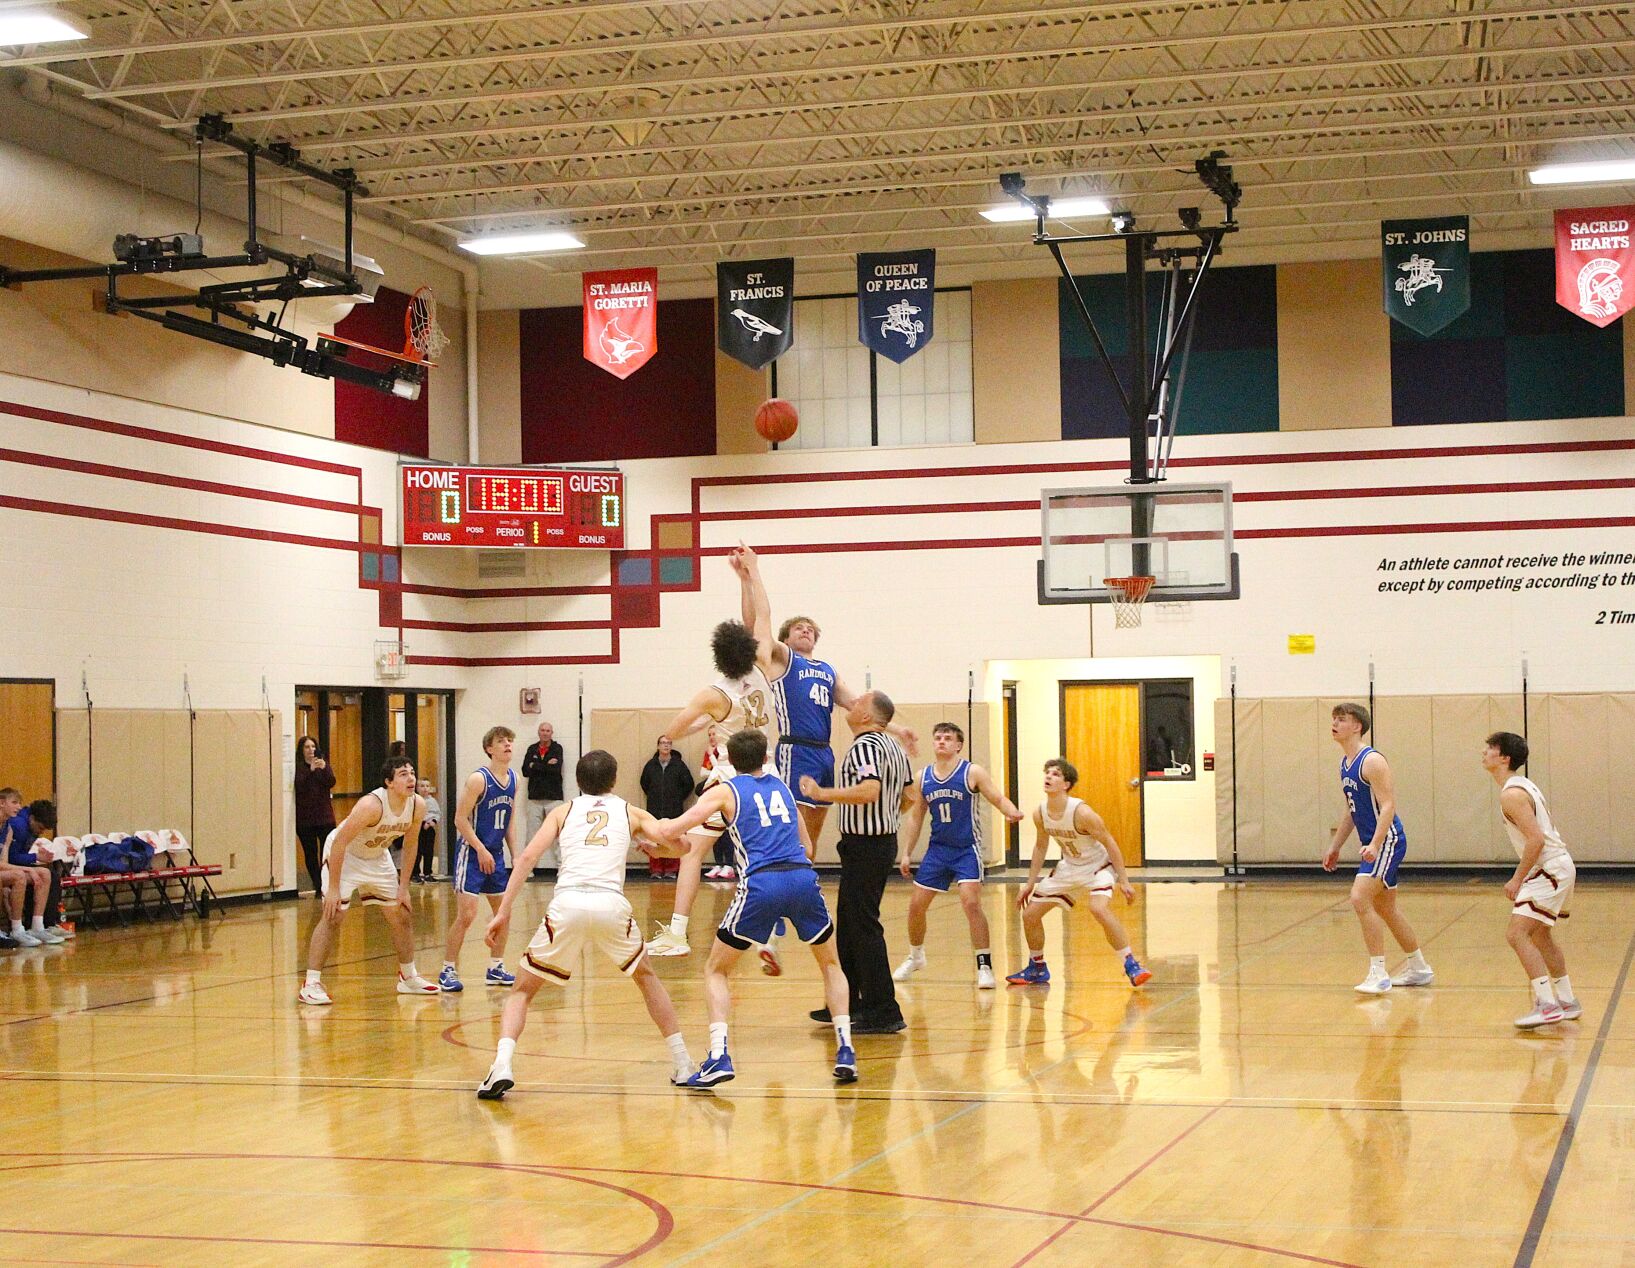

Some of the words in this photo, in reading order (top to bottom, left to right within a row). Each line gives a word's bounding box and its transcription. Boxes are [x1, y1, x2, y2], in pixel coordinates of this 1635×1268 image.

[1570, 219, 1629, 235] SACRED
[1385, 232, 1409, 245] ST.
[1412, 229, 1466, 244] JOHNS
[1570, 236, 1630, 251] HEARTS
[874, 263, 919, 277] QUEEN
[746, 273, 766, 285] ST.
[866, 279, 883, 292] OF
[885, 277, 928, 291] PEACE
[589, 284, 608, 296] ST.
[610, 281, 652, 295] MARIA
[729, 286, 784, 301] FRANCIS
[594, 295, 649, 311] GORETTI
[407, 470, 460, 489] HOME
[569, 475, 619, 493] GUEST
[441, 490, 461, 524] 0
[601, 495, 620, 527] 0
[422, 532, 451, 541] BONUS
[465, 526, 484, 534] POSS
[496, 527, 525, 538] PERIOD
[533, 521, 540, 544] 1
[578, 535, 606, 544] BONUS
[1377, 558, 1396, 571] An
[1399, 557, 1449, 571] athlete
[1454, 555, 1504, 569] cannot
[1506, 553, 1558, 568] receive
[1562, 552, 1585, 566] the
[1378, 578, 1425, 594] except
[1427, 578, 1444, 594] by
[1446, 575, 1524, 592] competing
[1525, 573, 1600, 589] according
[1602, 572, 1617, 586] to
[1595, 611, 1606, 624] 2
[809, 683, 829, 707] 40
[739, 690, 770, 728] 12
[488, 795, 513, 809] RANDOLP
[752, 790, 791, 827] 14
[494, 809, 507, 830] 11
[939, 803, 952, 823] 11
[584, 810, 609, 847] 2
